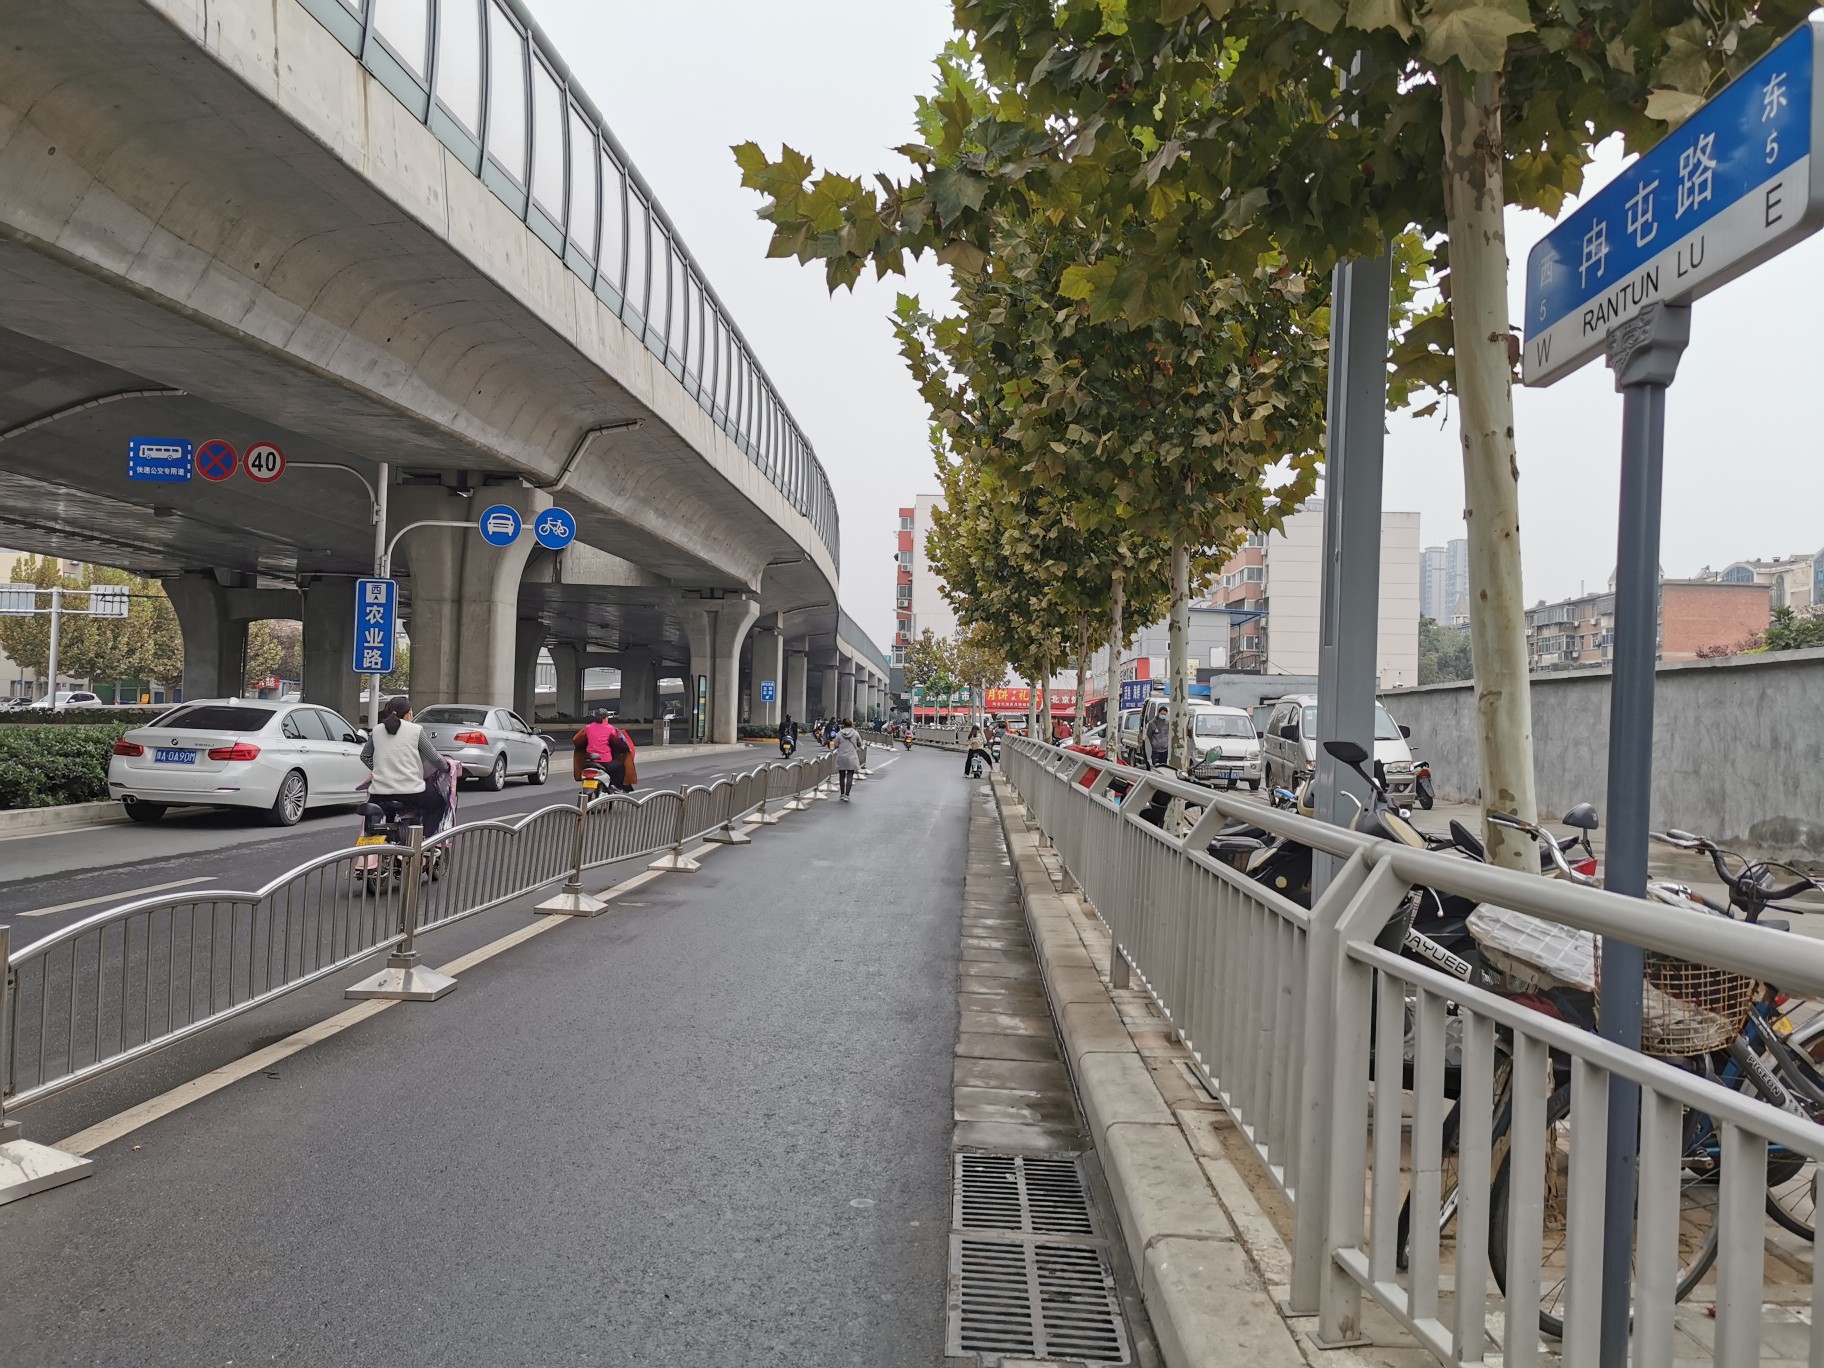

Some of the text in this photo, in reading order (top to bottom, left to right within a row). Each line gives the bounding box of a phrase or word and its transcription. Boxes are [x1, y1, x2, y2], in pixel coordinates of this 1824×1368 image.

[1539, 72, 1788, 290] 西 冉屯路 东
[1539, 131, 1779, 322] 5 5
[1536, 181, 1783, 368] W RANTUN LU E
[251, 451, 277, 473] 40
[371, 584, 383, 595] 西
[362, 605, 385, 669] 农业路
[1746, 1054, 1782, 1097] PIGEON
